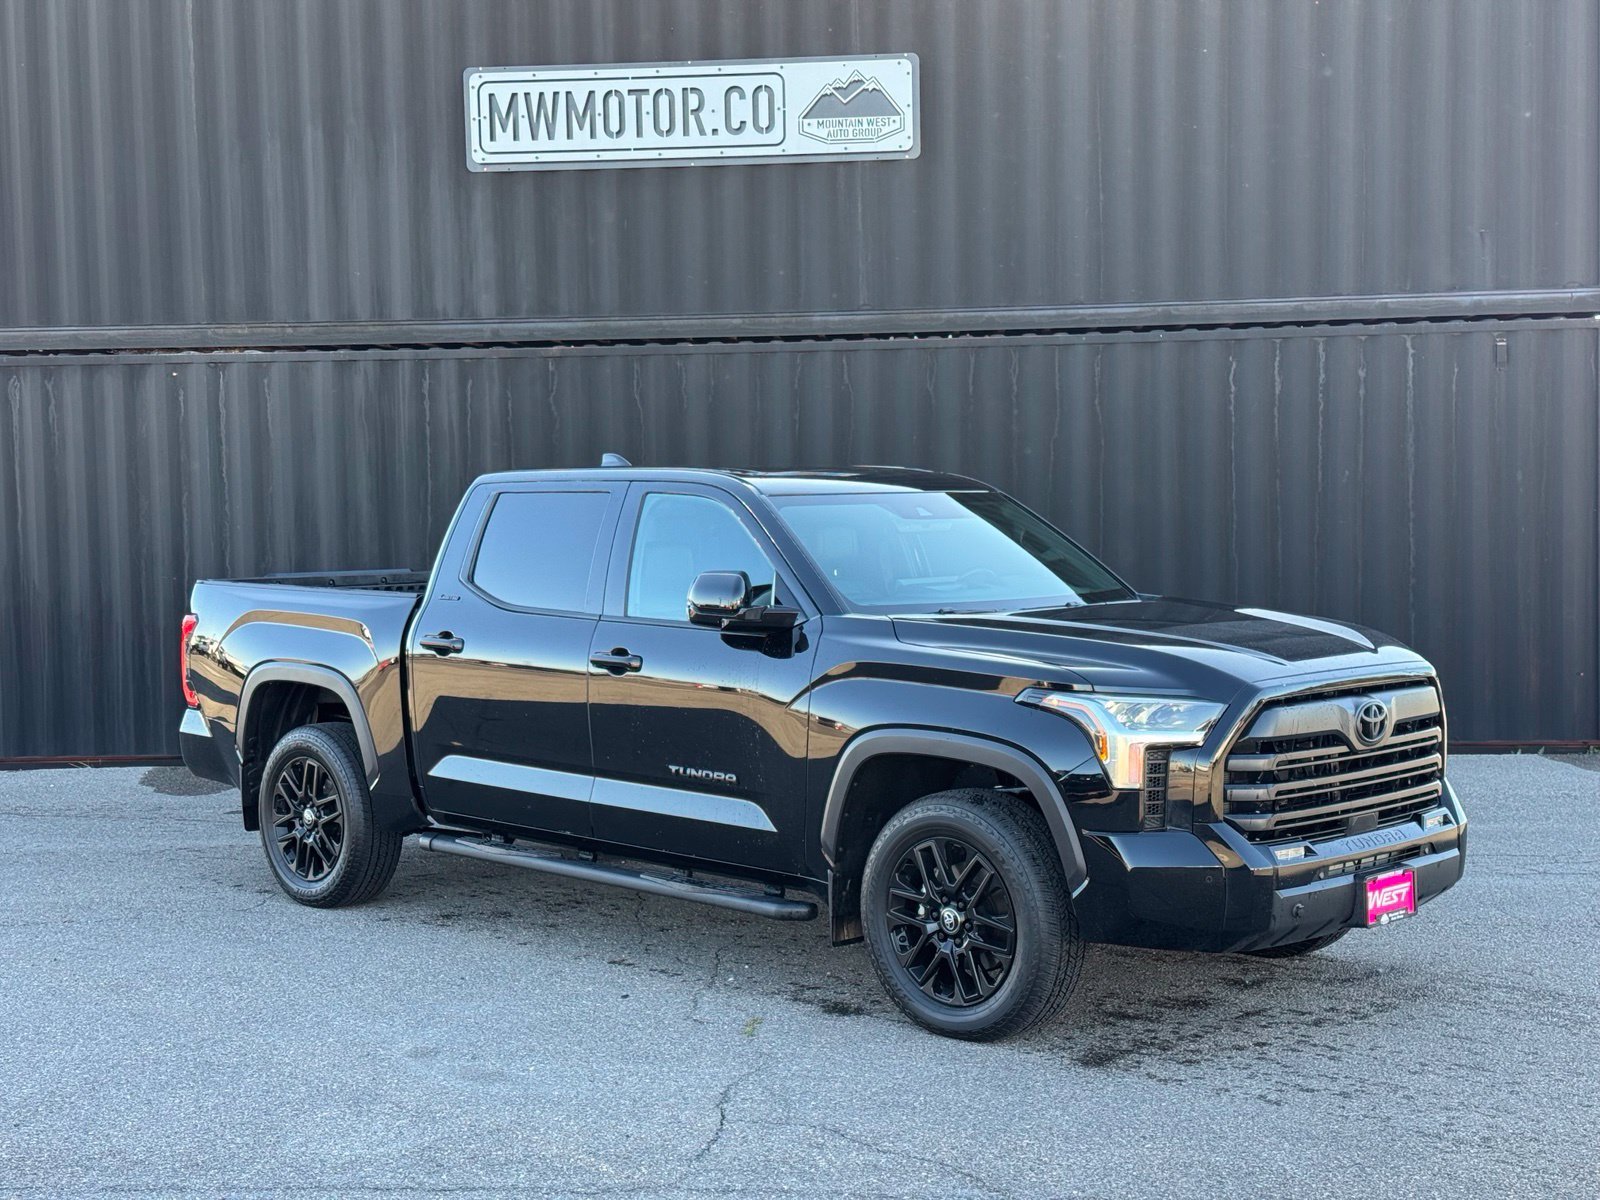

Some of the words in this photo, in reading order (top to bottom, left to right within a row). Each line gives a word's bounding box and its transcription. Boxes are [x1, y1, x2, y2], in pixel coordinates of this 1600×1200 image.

[488, 84, 776, 142] MWMOTOR.CO
[817, 118, 863, 129] MOUNTAIN
[866, 117, 891, 127] WEST
[826, 129, 849, 138] AUTO
[852, 128, 883, 138] GROUP
[668, 764, 737, 782] TUNDRA
[1367, 881, 1411, 910] WEST
